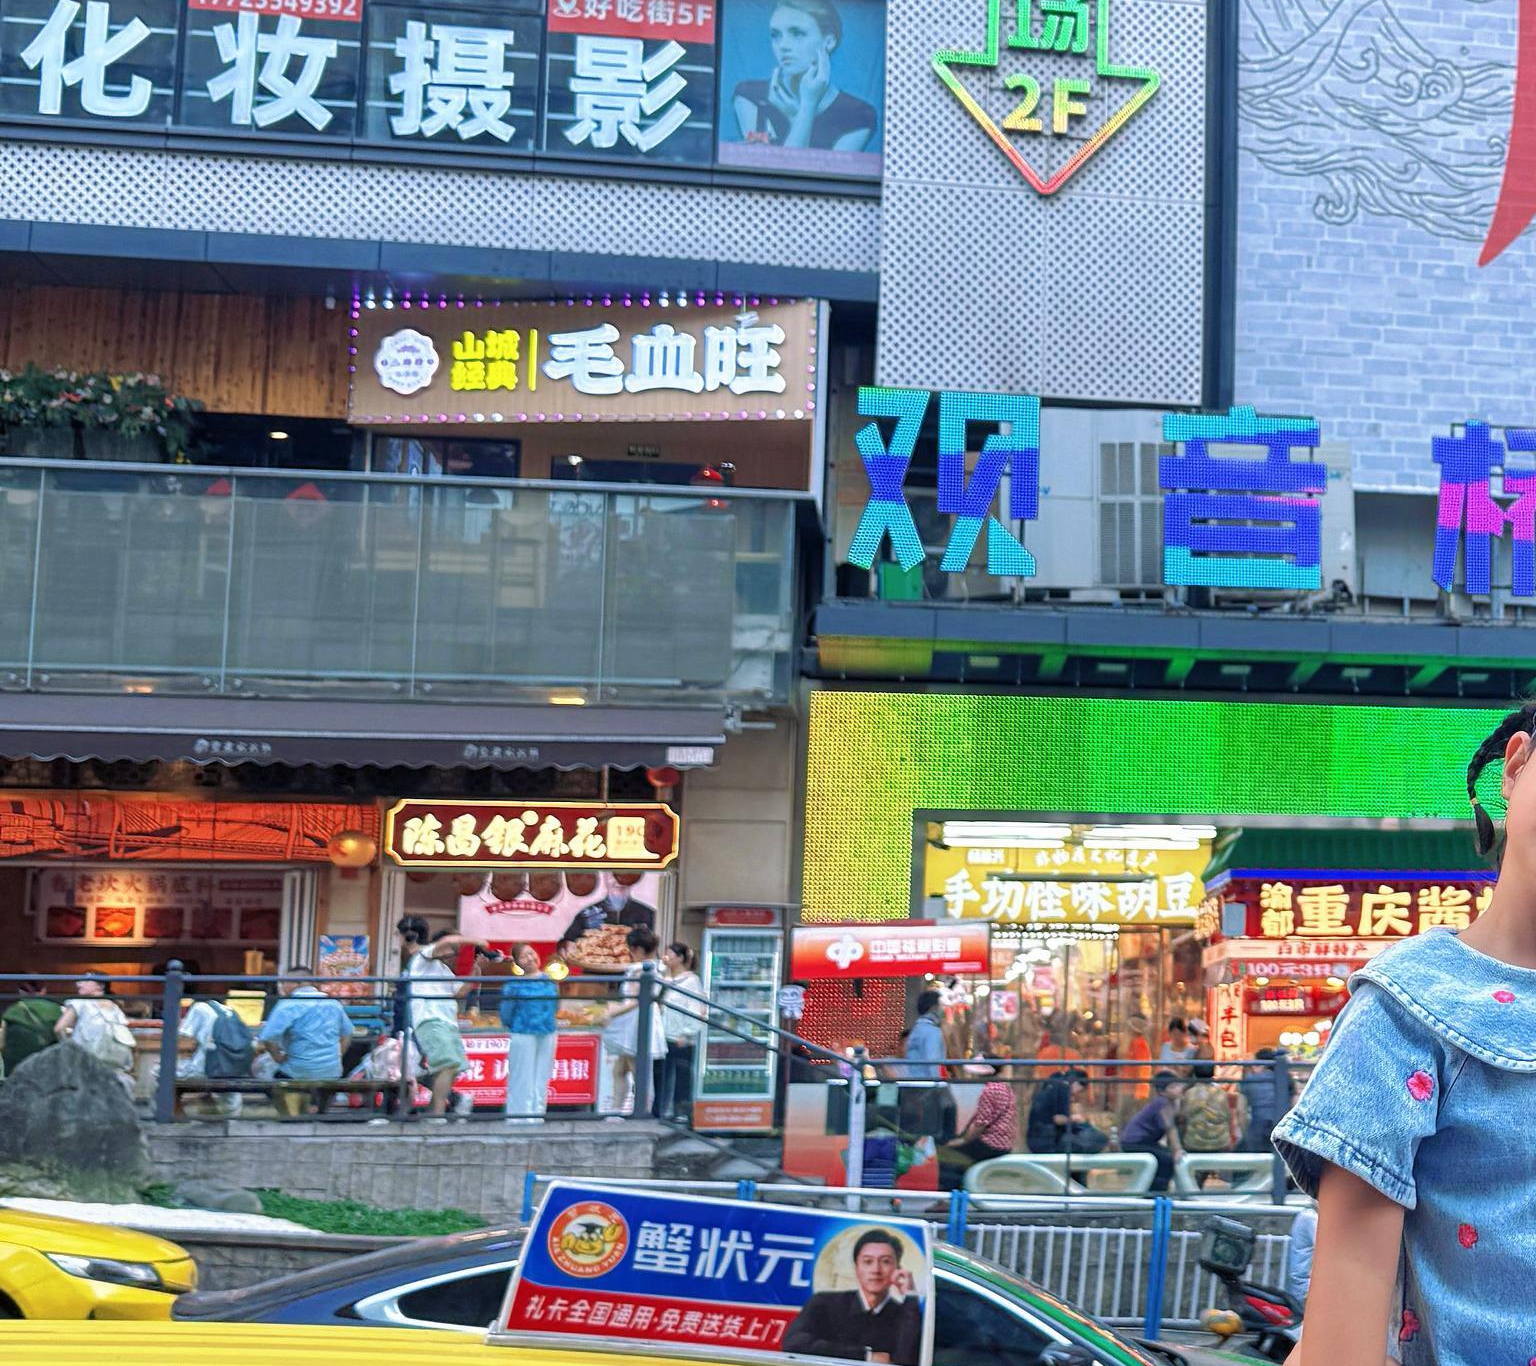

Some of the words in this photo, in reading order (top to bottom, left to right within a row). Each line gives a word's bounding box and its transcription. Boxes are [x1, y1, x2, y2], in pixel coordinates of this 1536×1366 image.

[1002, 72, 1092, 135] 2F
[542, 322, 787, 395] 毛血旺
[403, 812, 607, 858] 陈昌银麻花
[632, 1220, 815, 1288] 蟹状元
